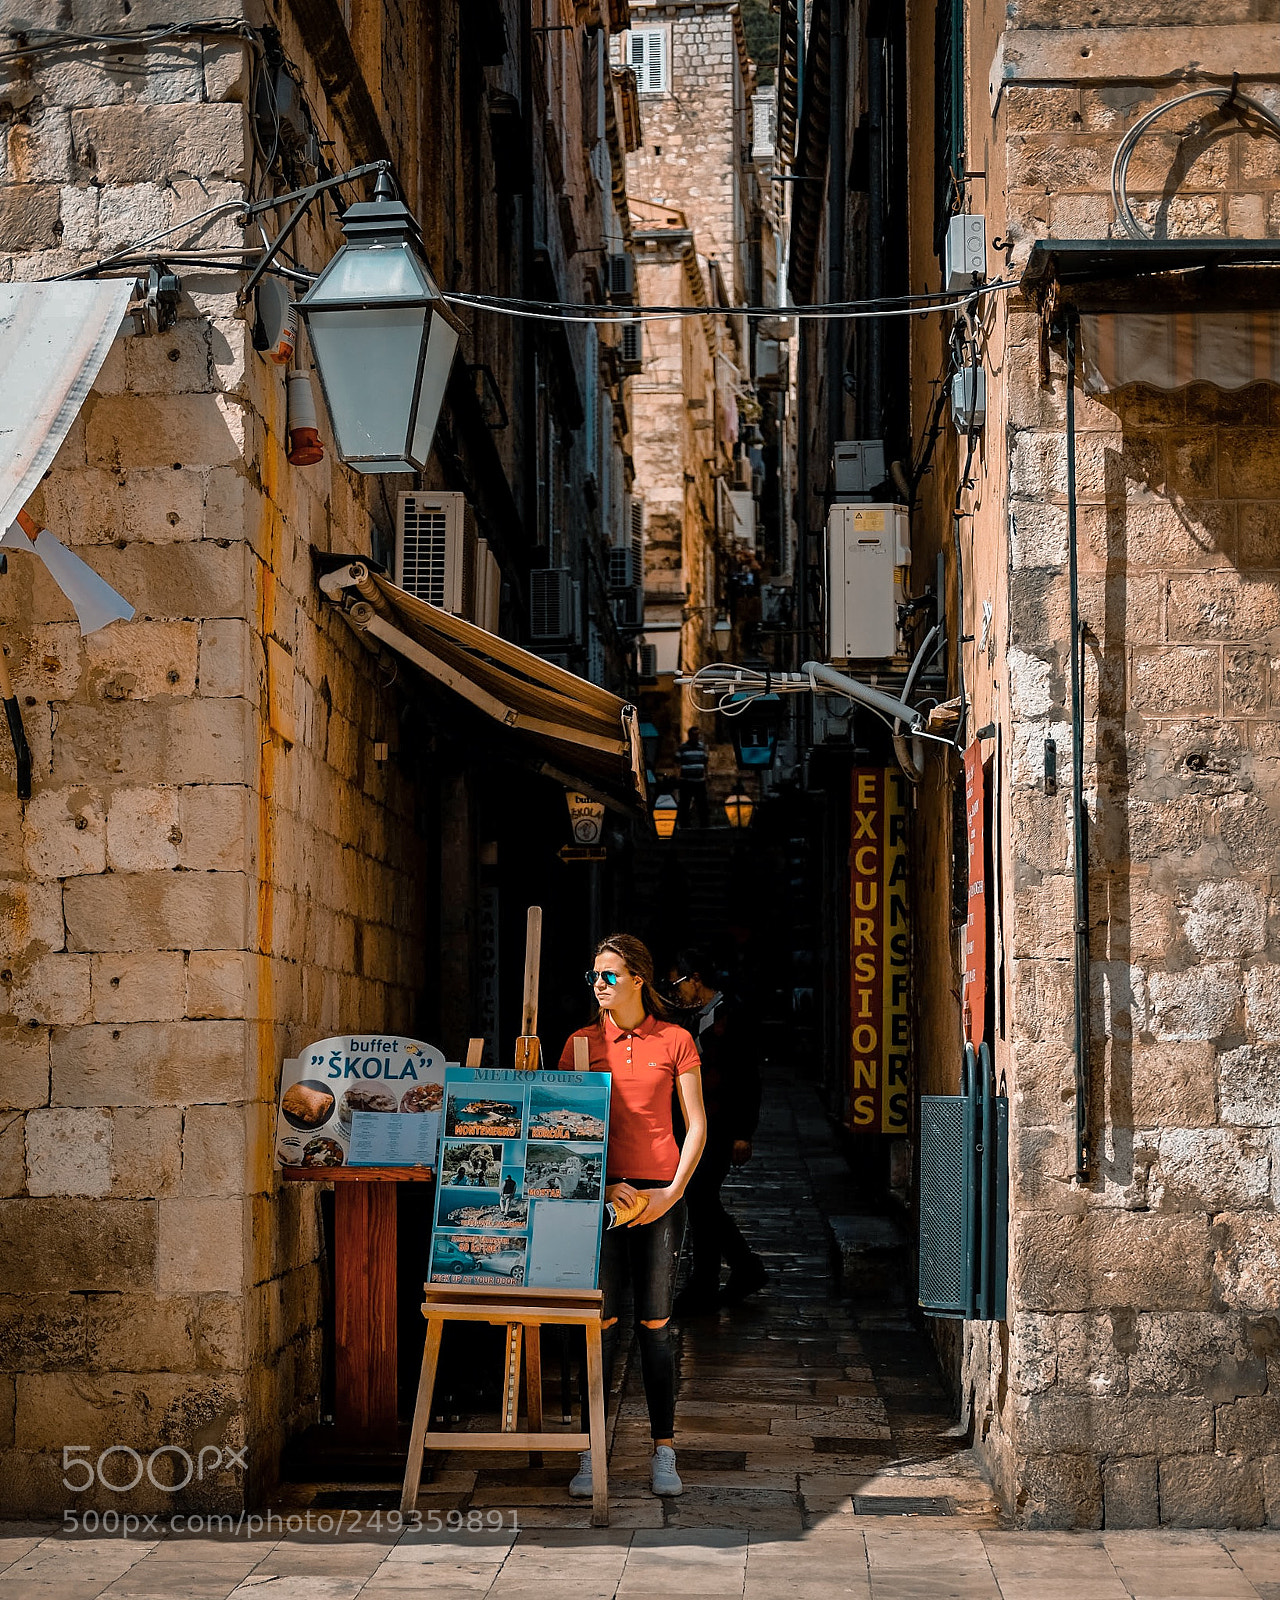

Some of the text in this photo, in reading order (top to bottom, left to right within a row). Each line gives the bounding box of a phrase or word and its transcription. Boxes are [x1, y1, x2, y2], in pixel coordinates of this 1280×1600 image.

[852, 774, 878, 1126] EXCURSIONS
[887, 774, 908, 1128] TRANSFERS
[350, 1038, 399, 1053] buffet
[473, 1067, 583, 1084] METRO tours
[454, 1124, 516, 1137] MONTENEGRO
[527, 1187, 562, 1198] MOSTAR
[432, 1273, 449, 1283] PICK
[451, 1274, 462, 1283] UP
[463, 1275, 472, 1284] AT
[474, 1276, 494, 1285] YOUR
